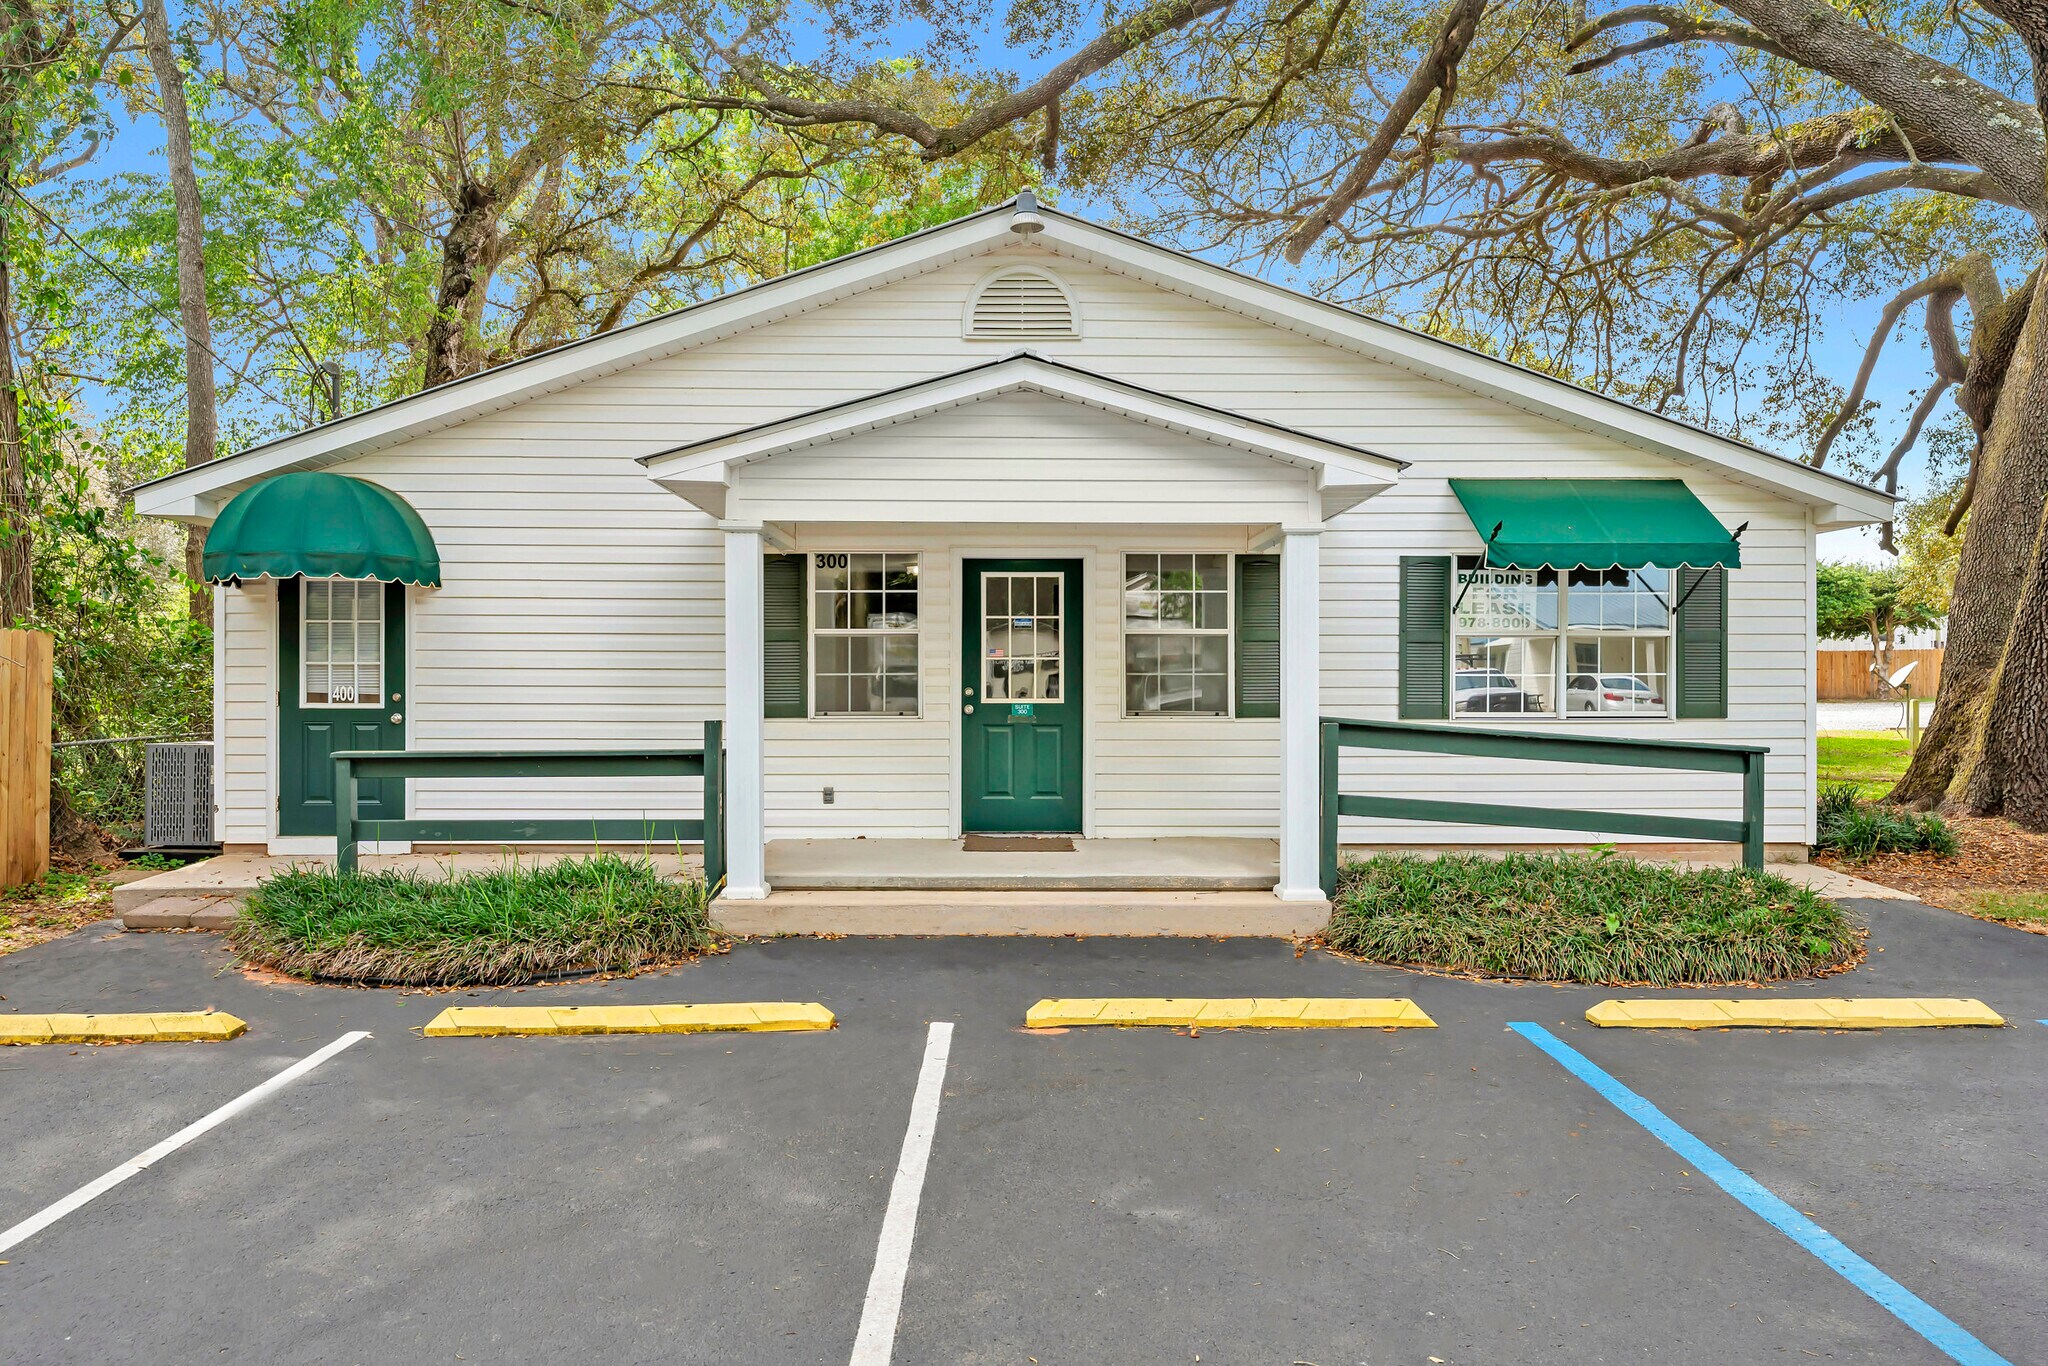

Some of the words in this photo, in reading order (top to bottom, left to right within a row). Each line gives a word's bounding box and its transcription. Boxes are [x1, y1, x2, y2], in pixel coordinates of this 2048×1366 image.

[816, 554, 848, 569] 300
[1458, 573, 1533, 585] BUILDING
[1472, 587, 1518, 600] FOR
[1459, 602, 1531, 615] LEASE
[332, 685, 354, 701] 400
